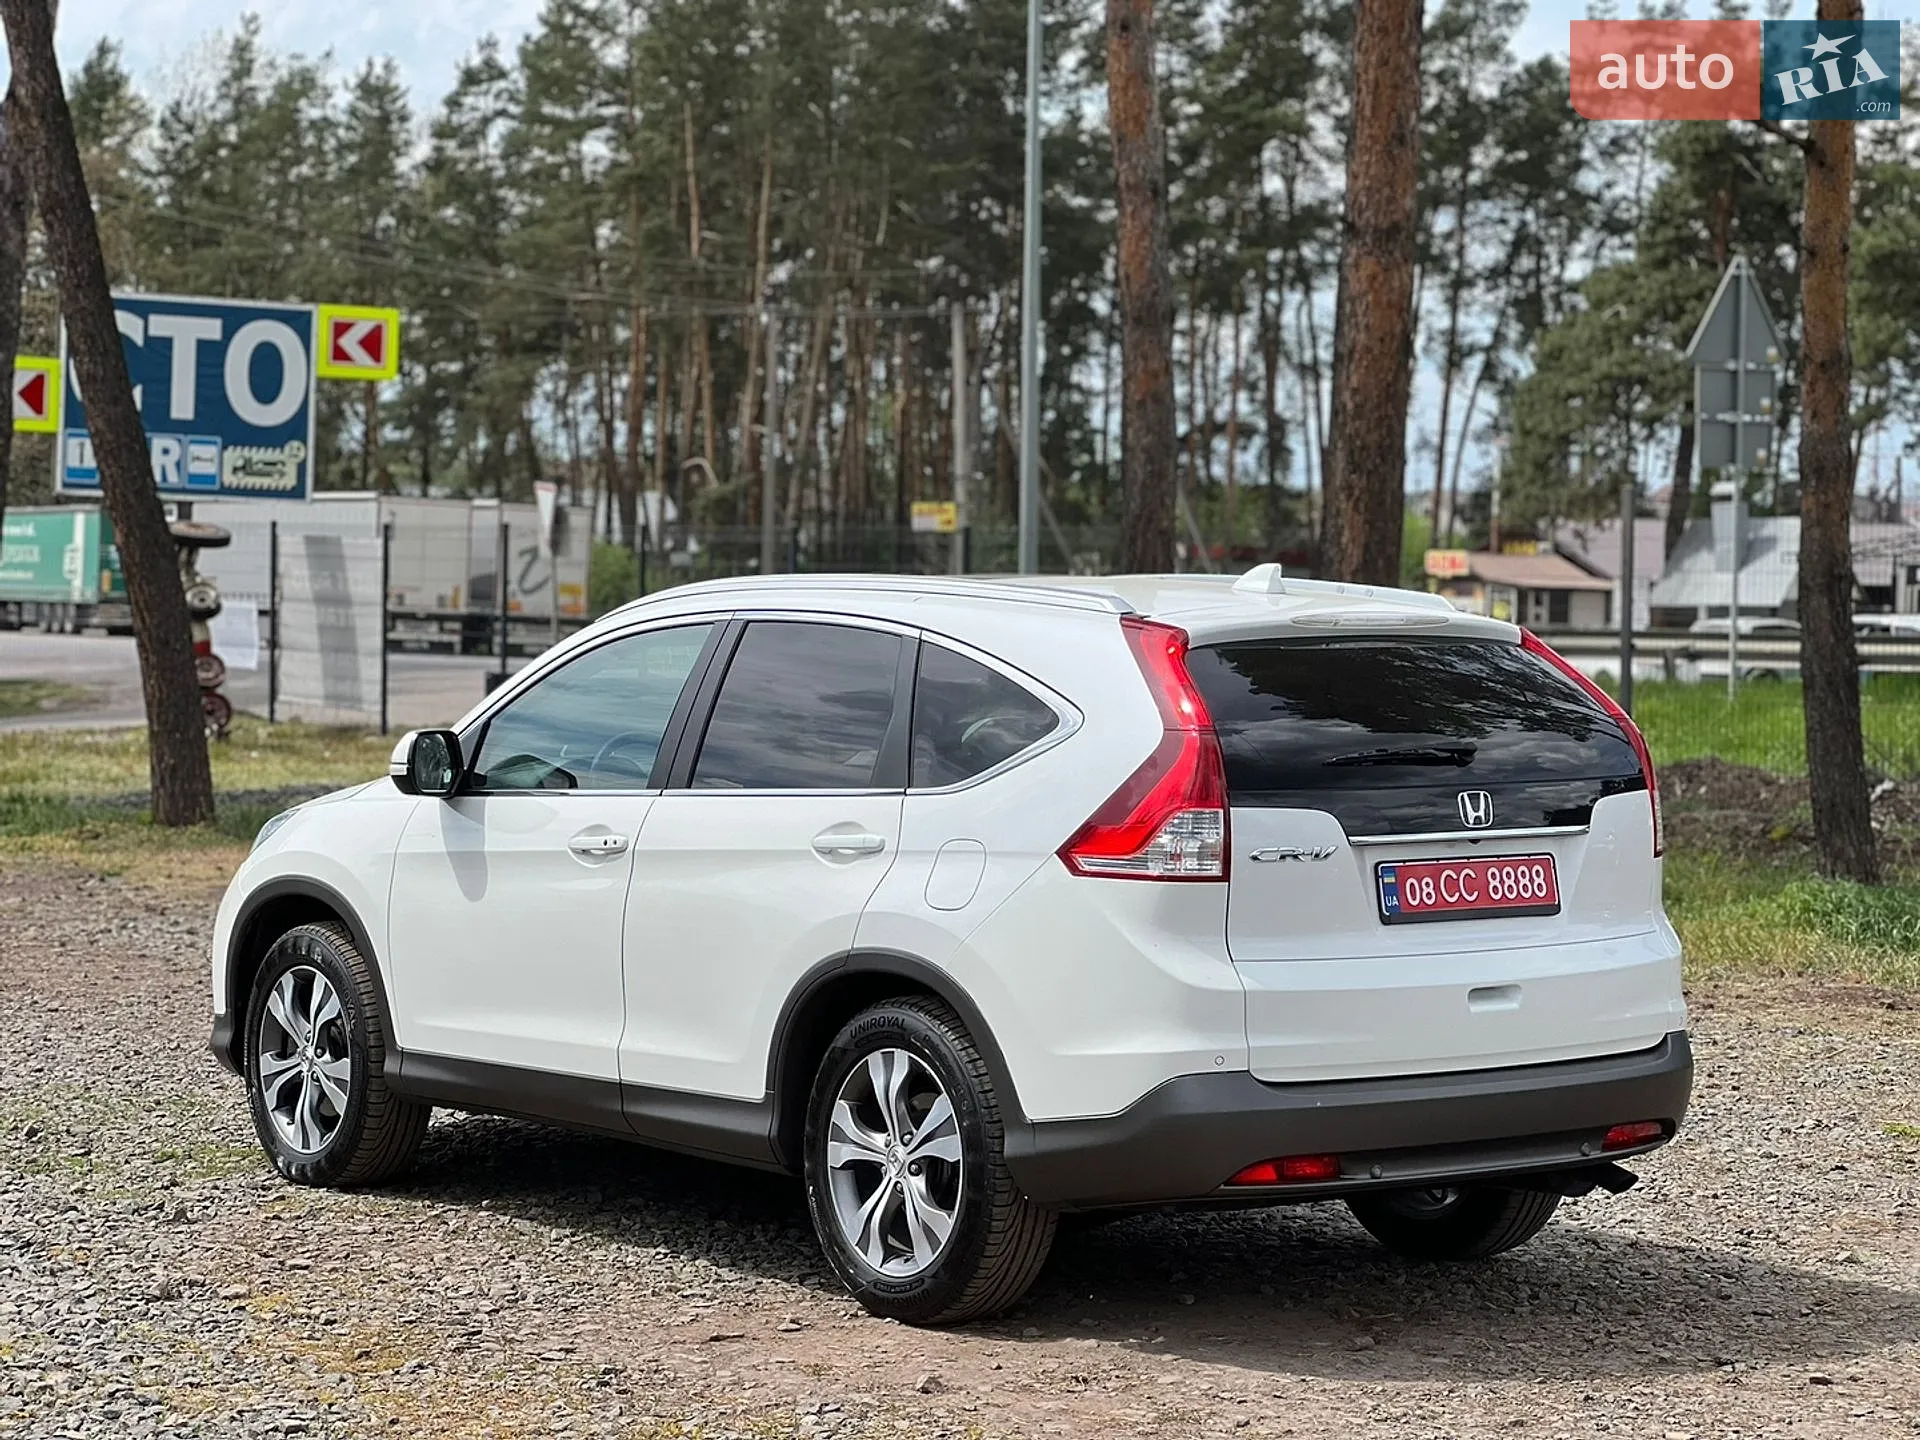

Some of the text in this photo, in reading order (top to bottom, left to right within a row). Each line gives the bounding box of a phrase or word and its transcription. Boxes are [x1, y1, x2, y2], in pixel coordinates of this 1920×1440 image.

[1248, 845, 1339, 863] CR-V
[1405, 864, 1547, 906] 08 CC 8888
[1385, 895, 1399, 907] UA
[849, 1015, 907, 1040] UNIROYAL
